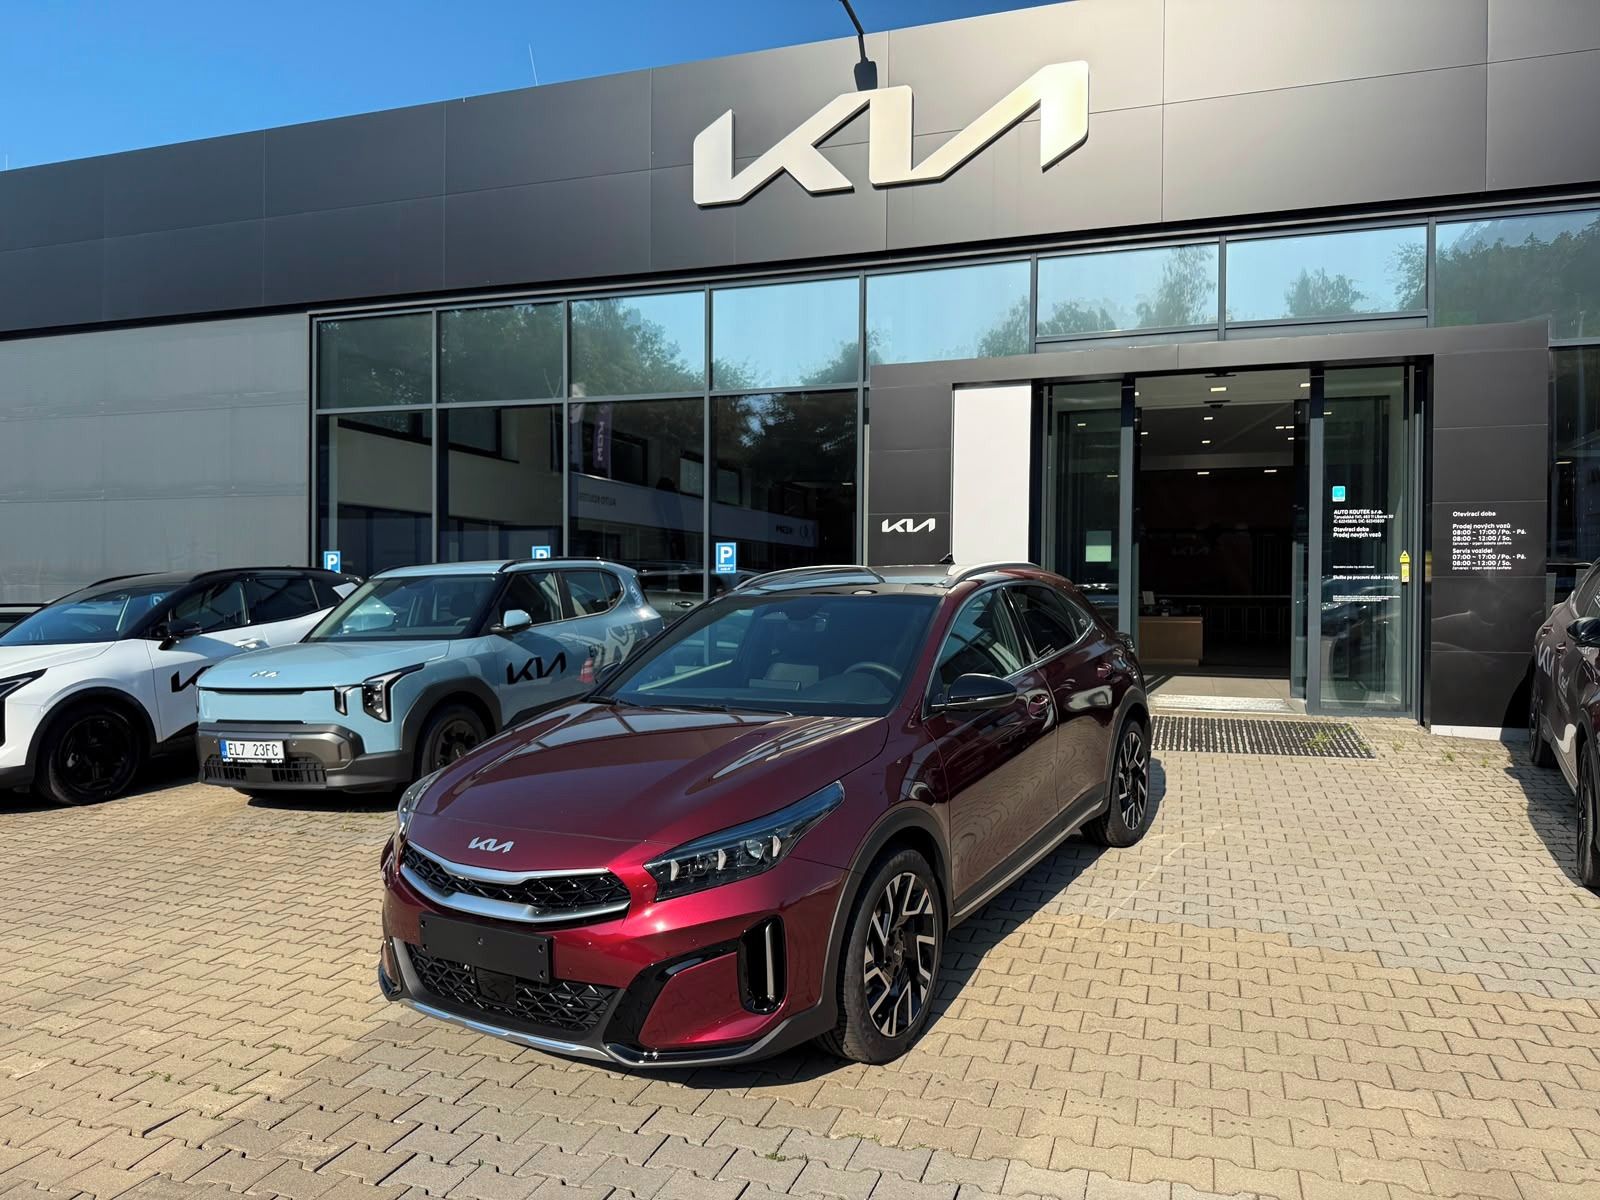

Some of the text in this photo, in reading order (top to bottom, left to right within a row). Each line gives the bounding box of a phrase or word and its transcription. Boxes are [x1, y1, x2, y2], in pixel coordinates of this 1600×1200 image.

[693, 60, 1090, 206] KIA
[881, 517, 936, 533] KIA
[328, 554, 337, 570] P
[720, 546, 732, 564] P
[506, 651, 567, 685] KIA
[228, 742, 278, 757] EL7 23FC
[468, 836, 514, 854] KIA
